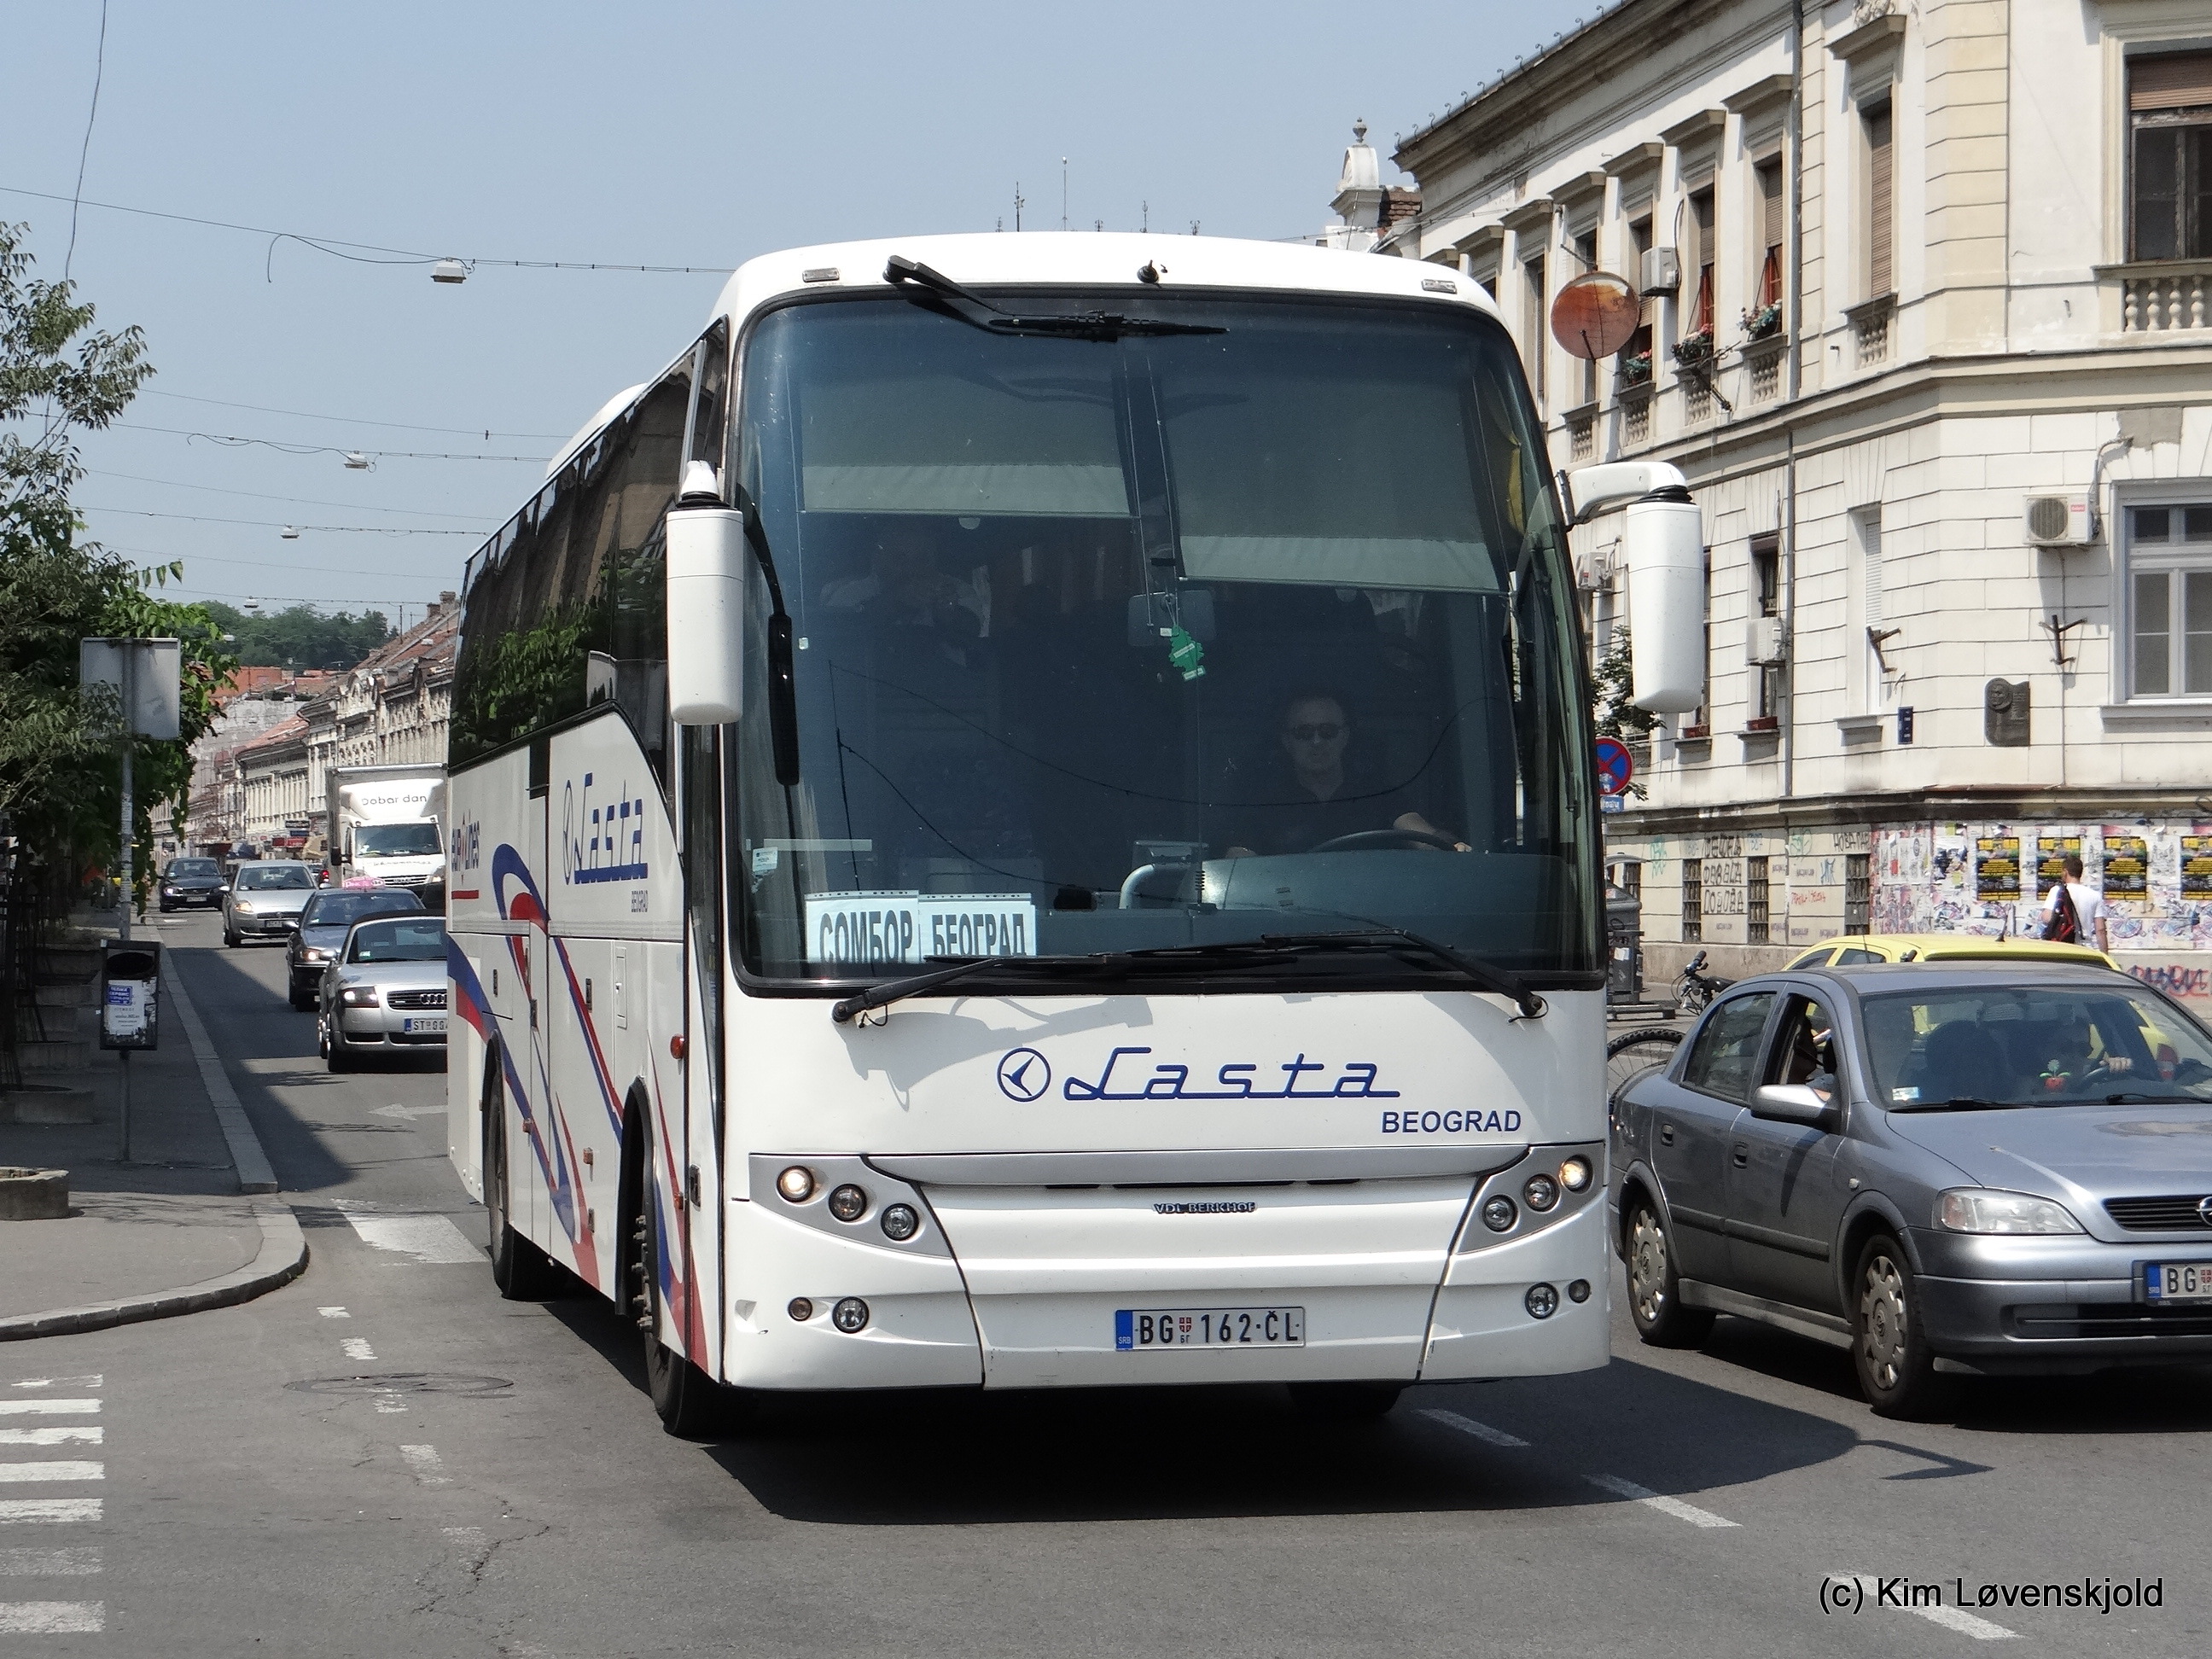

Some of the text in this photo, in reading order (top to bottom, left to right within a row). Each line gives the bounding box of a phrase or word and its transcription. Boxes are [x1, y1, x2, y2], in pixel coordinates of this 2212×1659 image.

[403, 795, 427, 803] dan
[819, 910, 1027, 963] СОМБОР БЕОГРАД
[1063, 1046, 1400, 1101] Lasta
[1381, 1110, 1522, 1133] BEOGRAD
[1154, 1202, 1255, 1214] VDL BERKHOF
[2167, 1267, 2197, 1294] BG
[1118, 1336, 1132, 1345] SRB
[1139, 1315, 1173, 1344] BG
